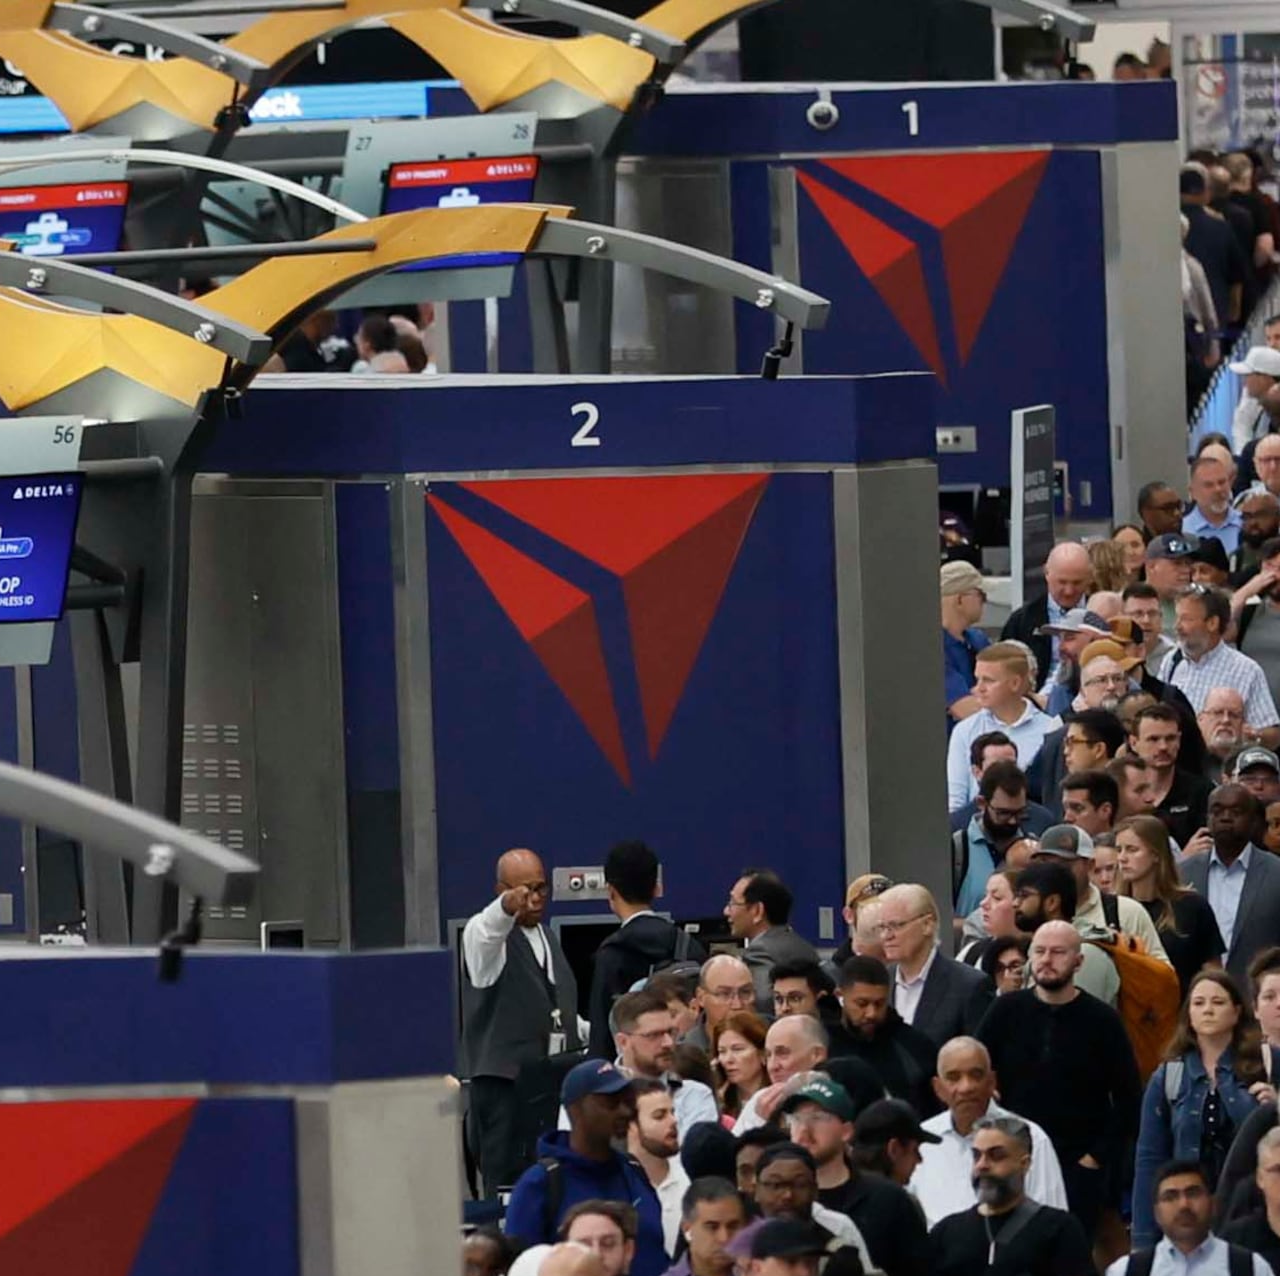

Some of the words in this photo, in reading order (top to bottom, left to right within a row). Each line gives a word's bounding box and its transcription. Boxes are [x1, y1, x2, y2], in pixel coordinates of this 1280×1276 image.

[902, 101, 919, 136] 1
[355, 136, 372, 151] 27
[570, 401, 601, 447] 2
[53, 425, 74, 444] 56
[25, 485, 63, 498] DELTA
[25, 595, 34, 606] ID
